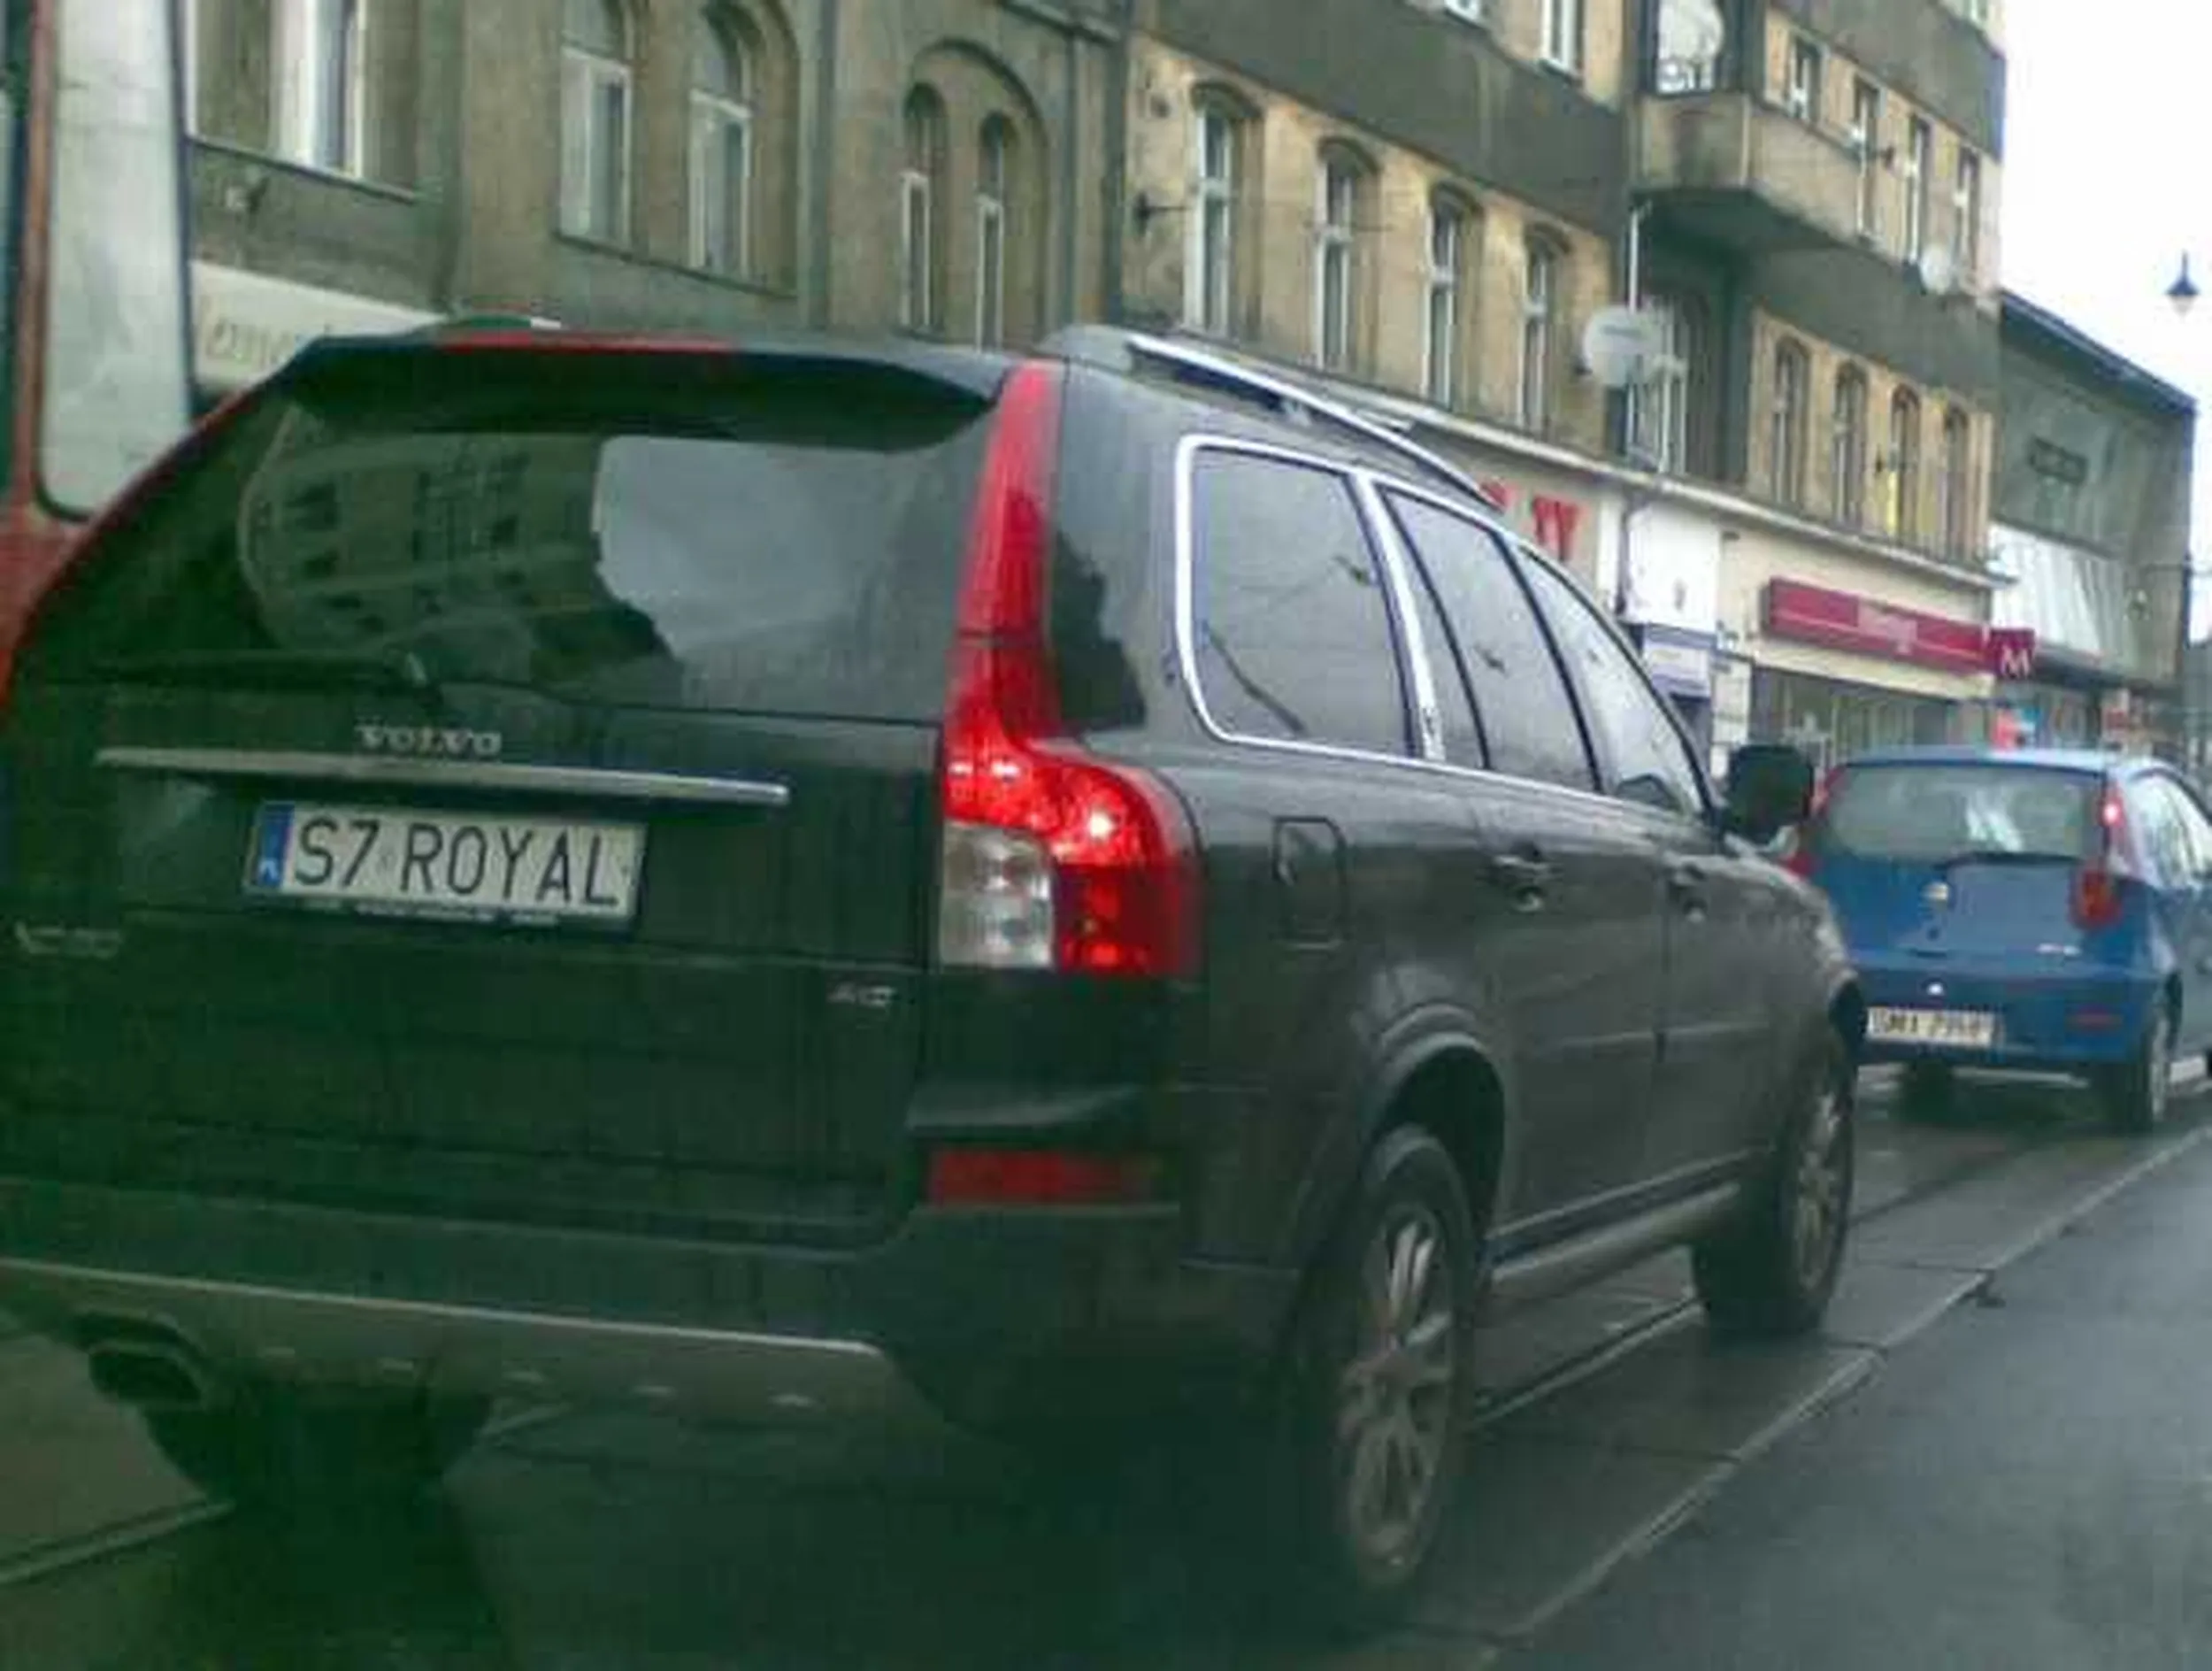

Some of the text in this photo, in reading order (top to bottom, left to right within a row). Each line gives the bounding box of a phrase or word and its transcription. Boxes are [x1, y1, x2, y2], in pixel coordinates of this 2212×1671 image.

[354, 725, 503, 756] VOLVO
[295, 815, 619, 907] S7 ROYAL
